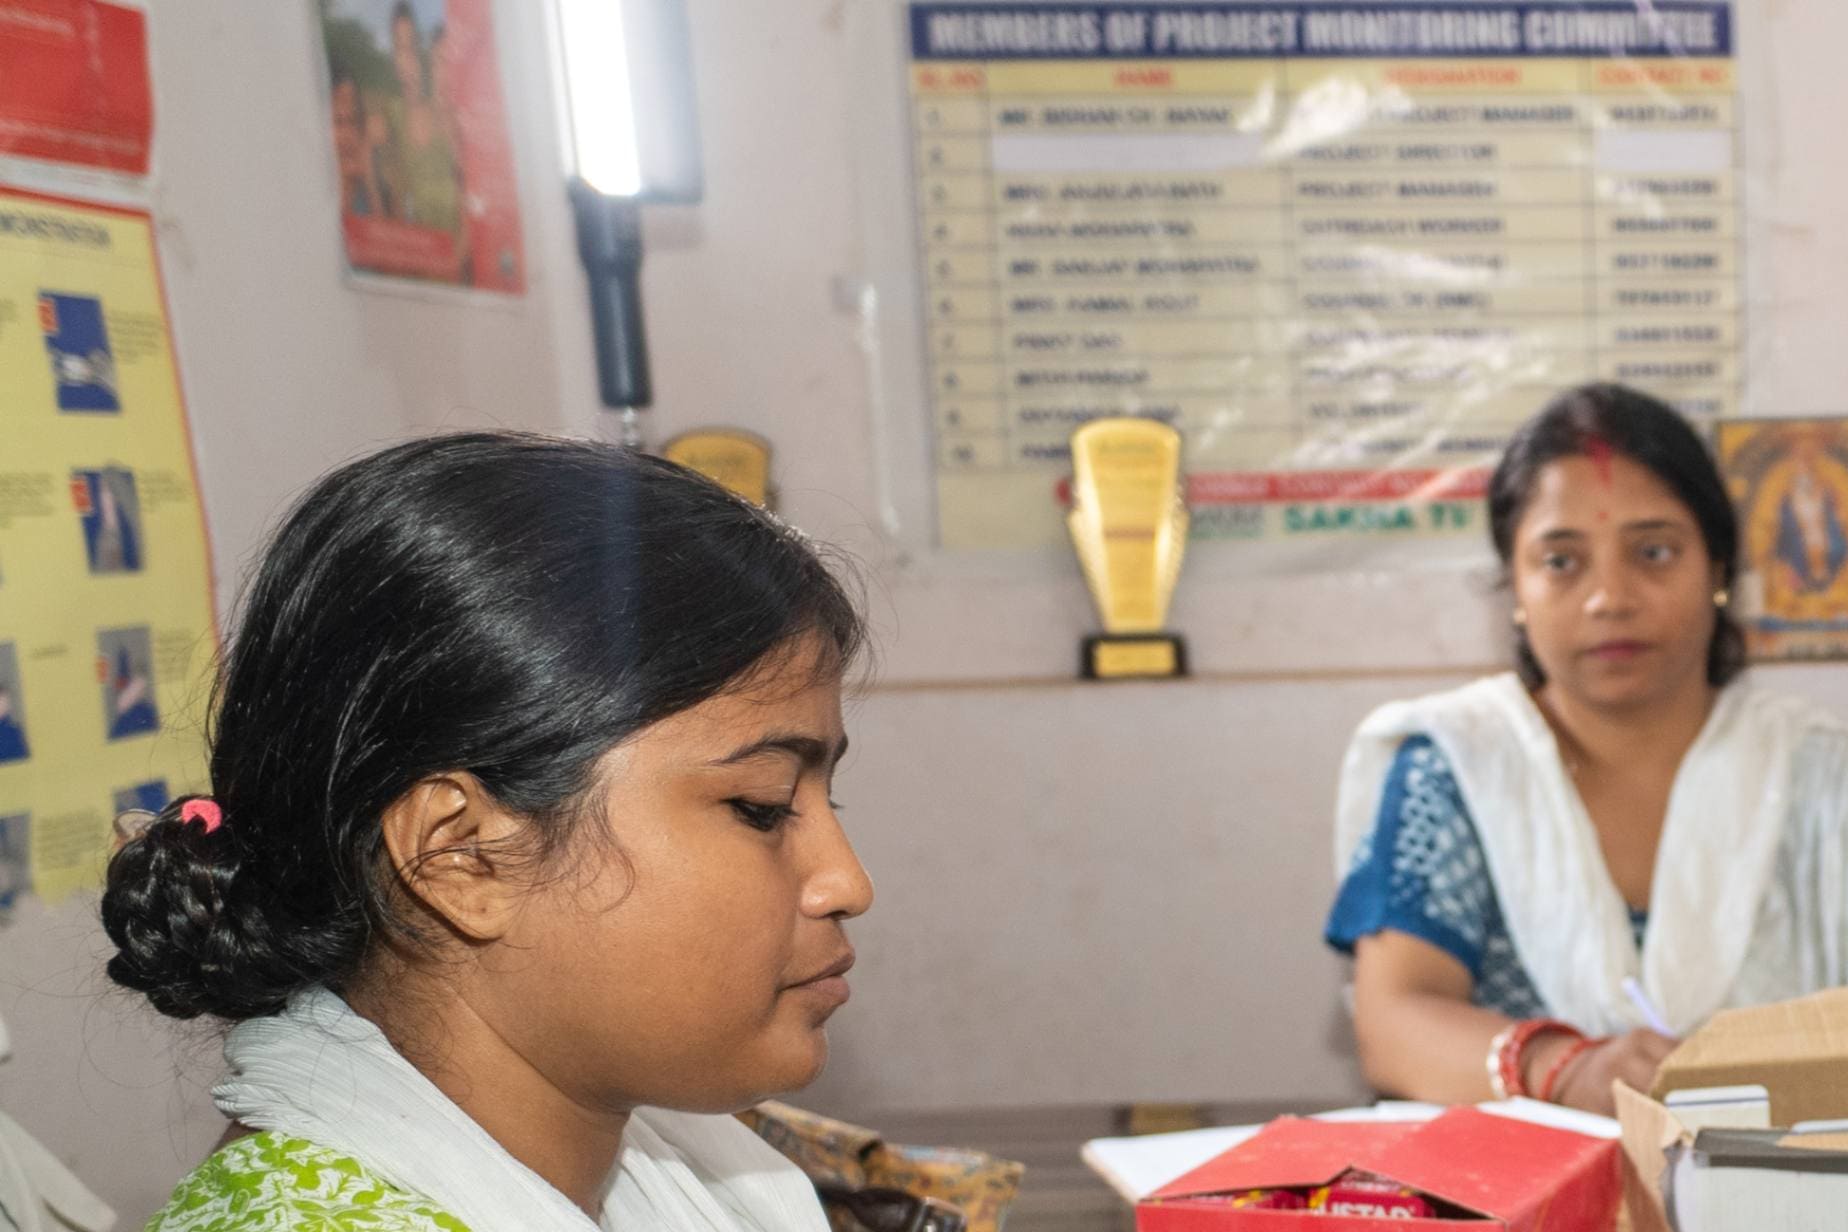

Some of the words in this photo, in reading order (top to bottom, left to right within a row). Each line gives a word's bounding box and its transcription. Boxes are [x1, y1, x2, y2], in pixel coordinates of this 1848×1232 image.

[928, 11, 1101, 52] MEMBERS
[1106, 11, 1148, 50] OF
[1153, 10, 1298, 50] PROJECT
[1305, 10, 1518, 49] MONITORING
[1526, 10, 1718, 48] COMMITTEE
